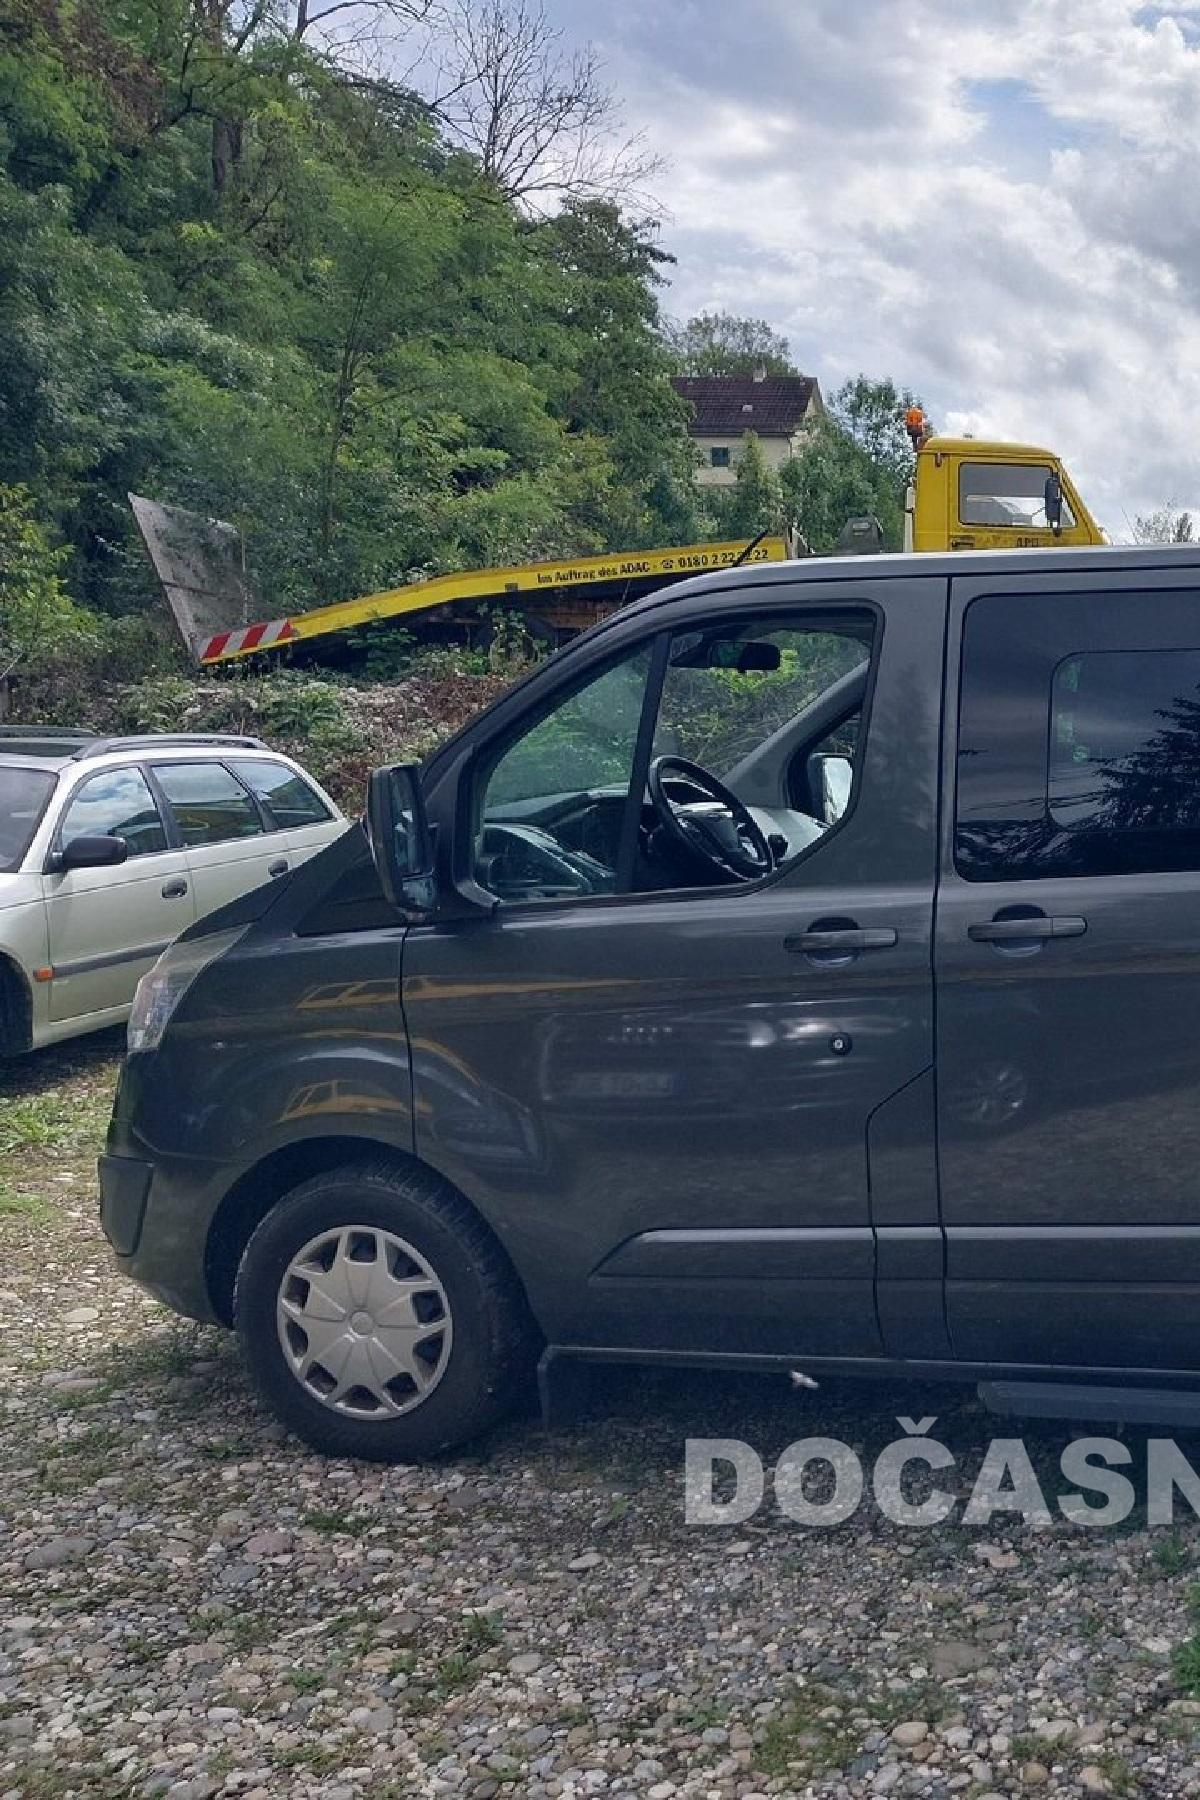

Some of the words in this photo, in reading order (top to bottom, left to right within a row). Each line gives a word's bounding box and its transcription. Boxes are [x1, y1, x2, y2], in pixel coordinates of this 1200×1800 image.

[555, 569, 596, 581] Auftrag
[598, 566, 617, 577] des
[620, 561, 650, 574] ADAC
